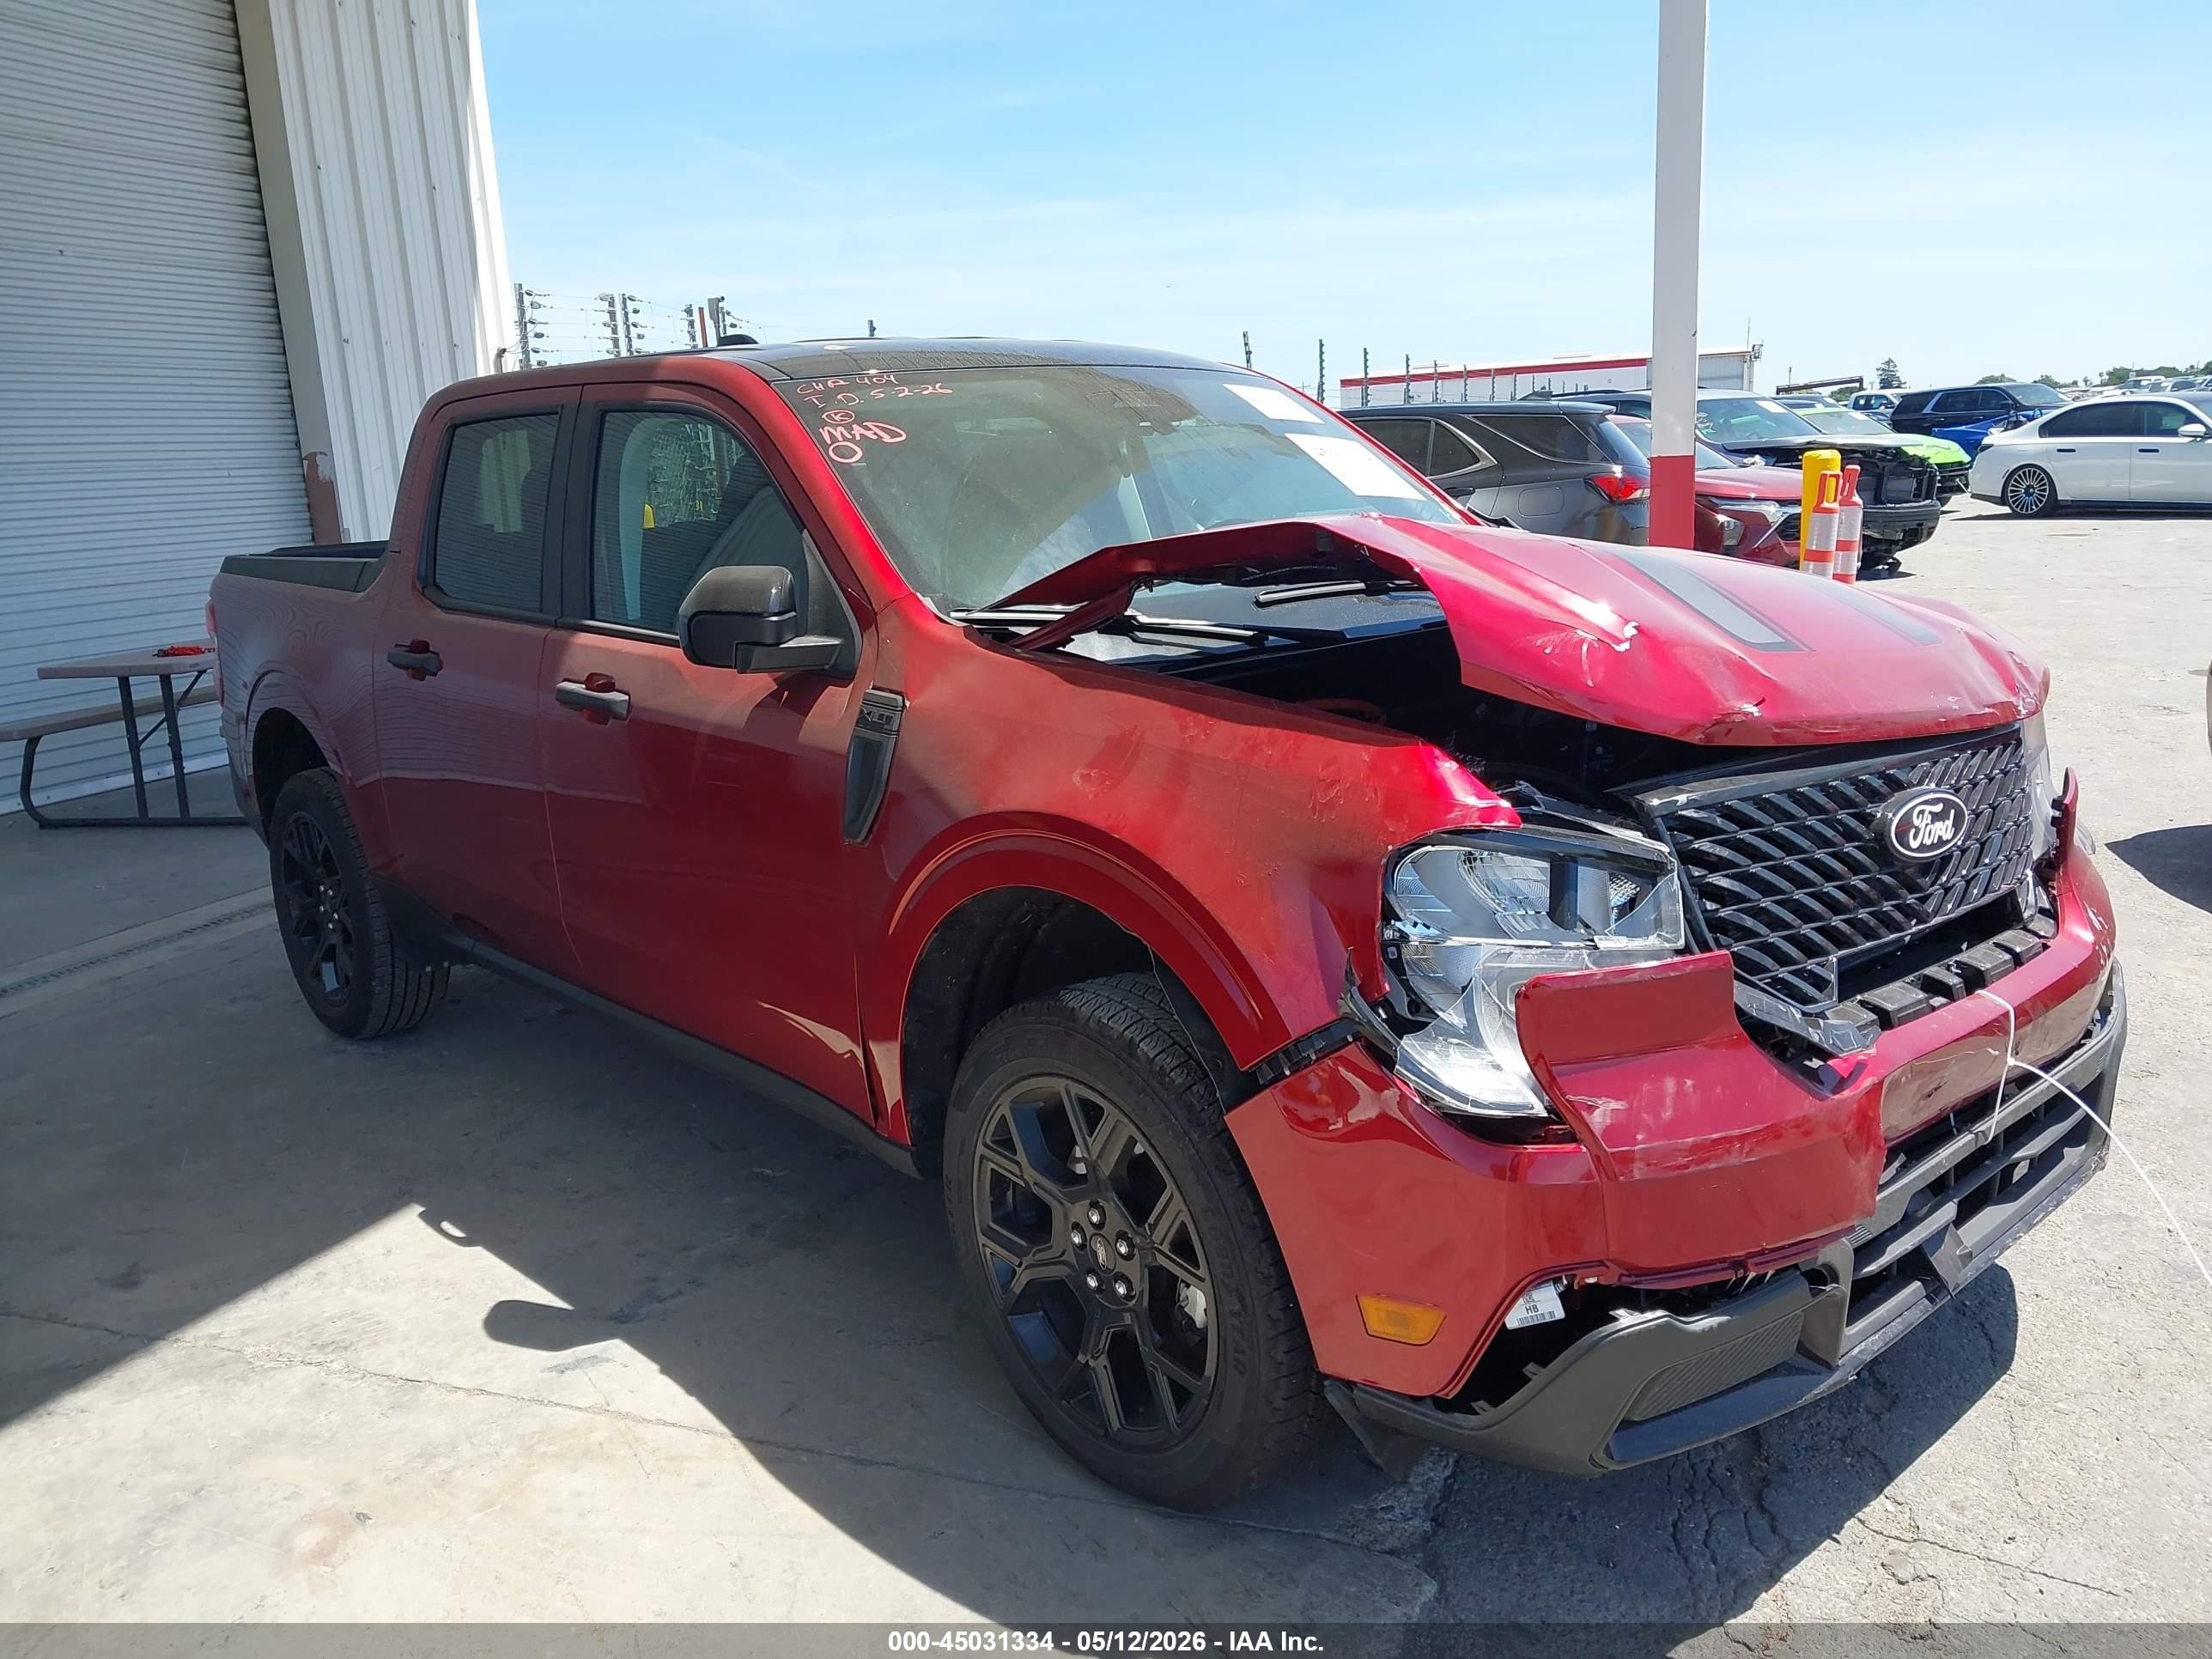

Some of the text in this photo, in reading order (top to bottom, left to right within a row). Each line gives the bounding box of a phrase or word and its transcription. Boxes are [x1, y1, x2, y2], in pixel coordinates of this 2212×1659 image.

[856, 374, 899, 386] 404
[819, 421, 907, 445] MAD
[1909, 802, 1955, 849] Ford
[1201, 1208, 1247, 1377] OODYEAR
[1525, 1304, 1540, 1315] HB
